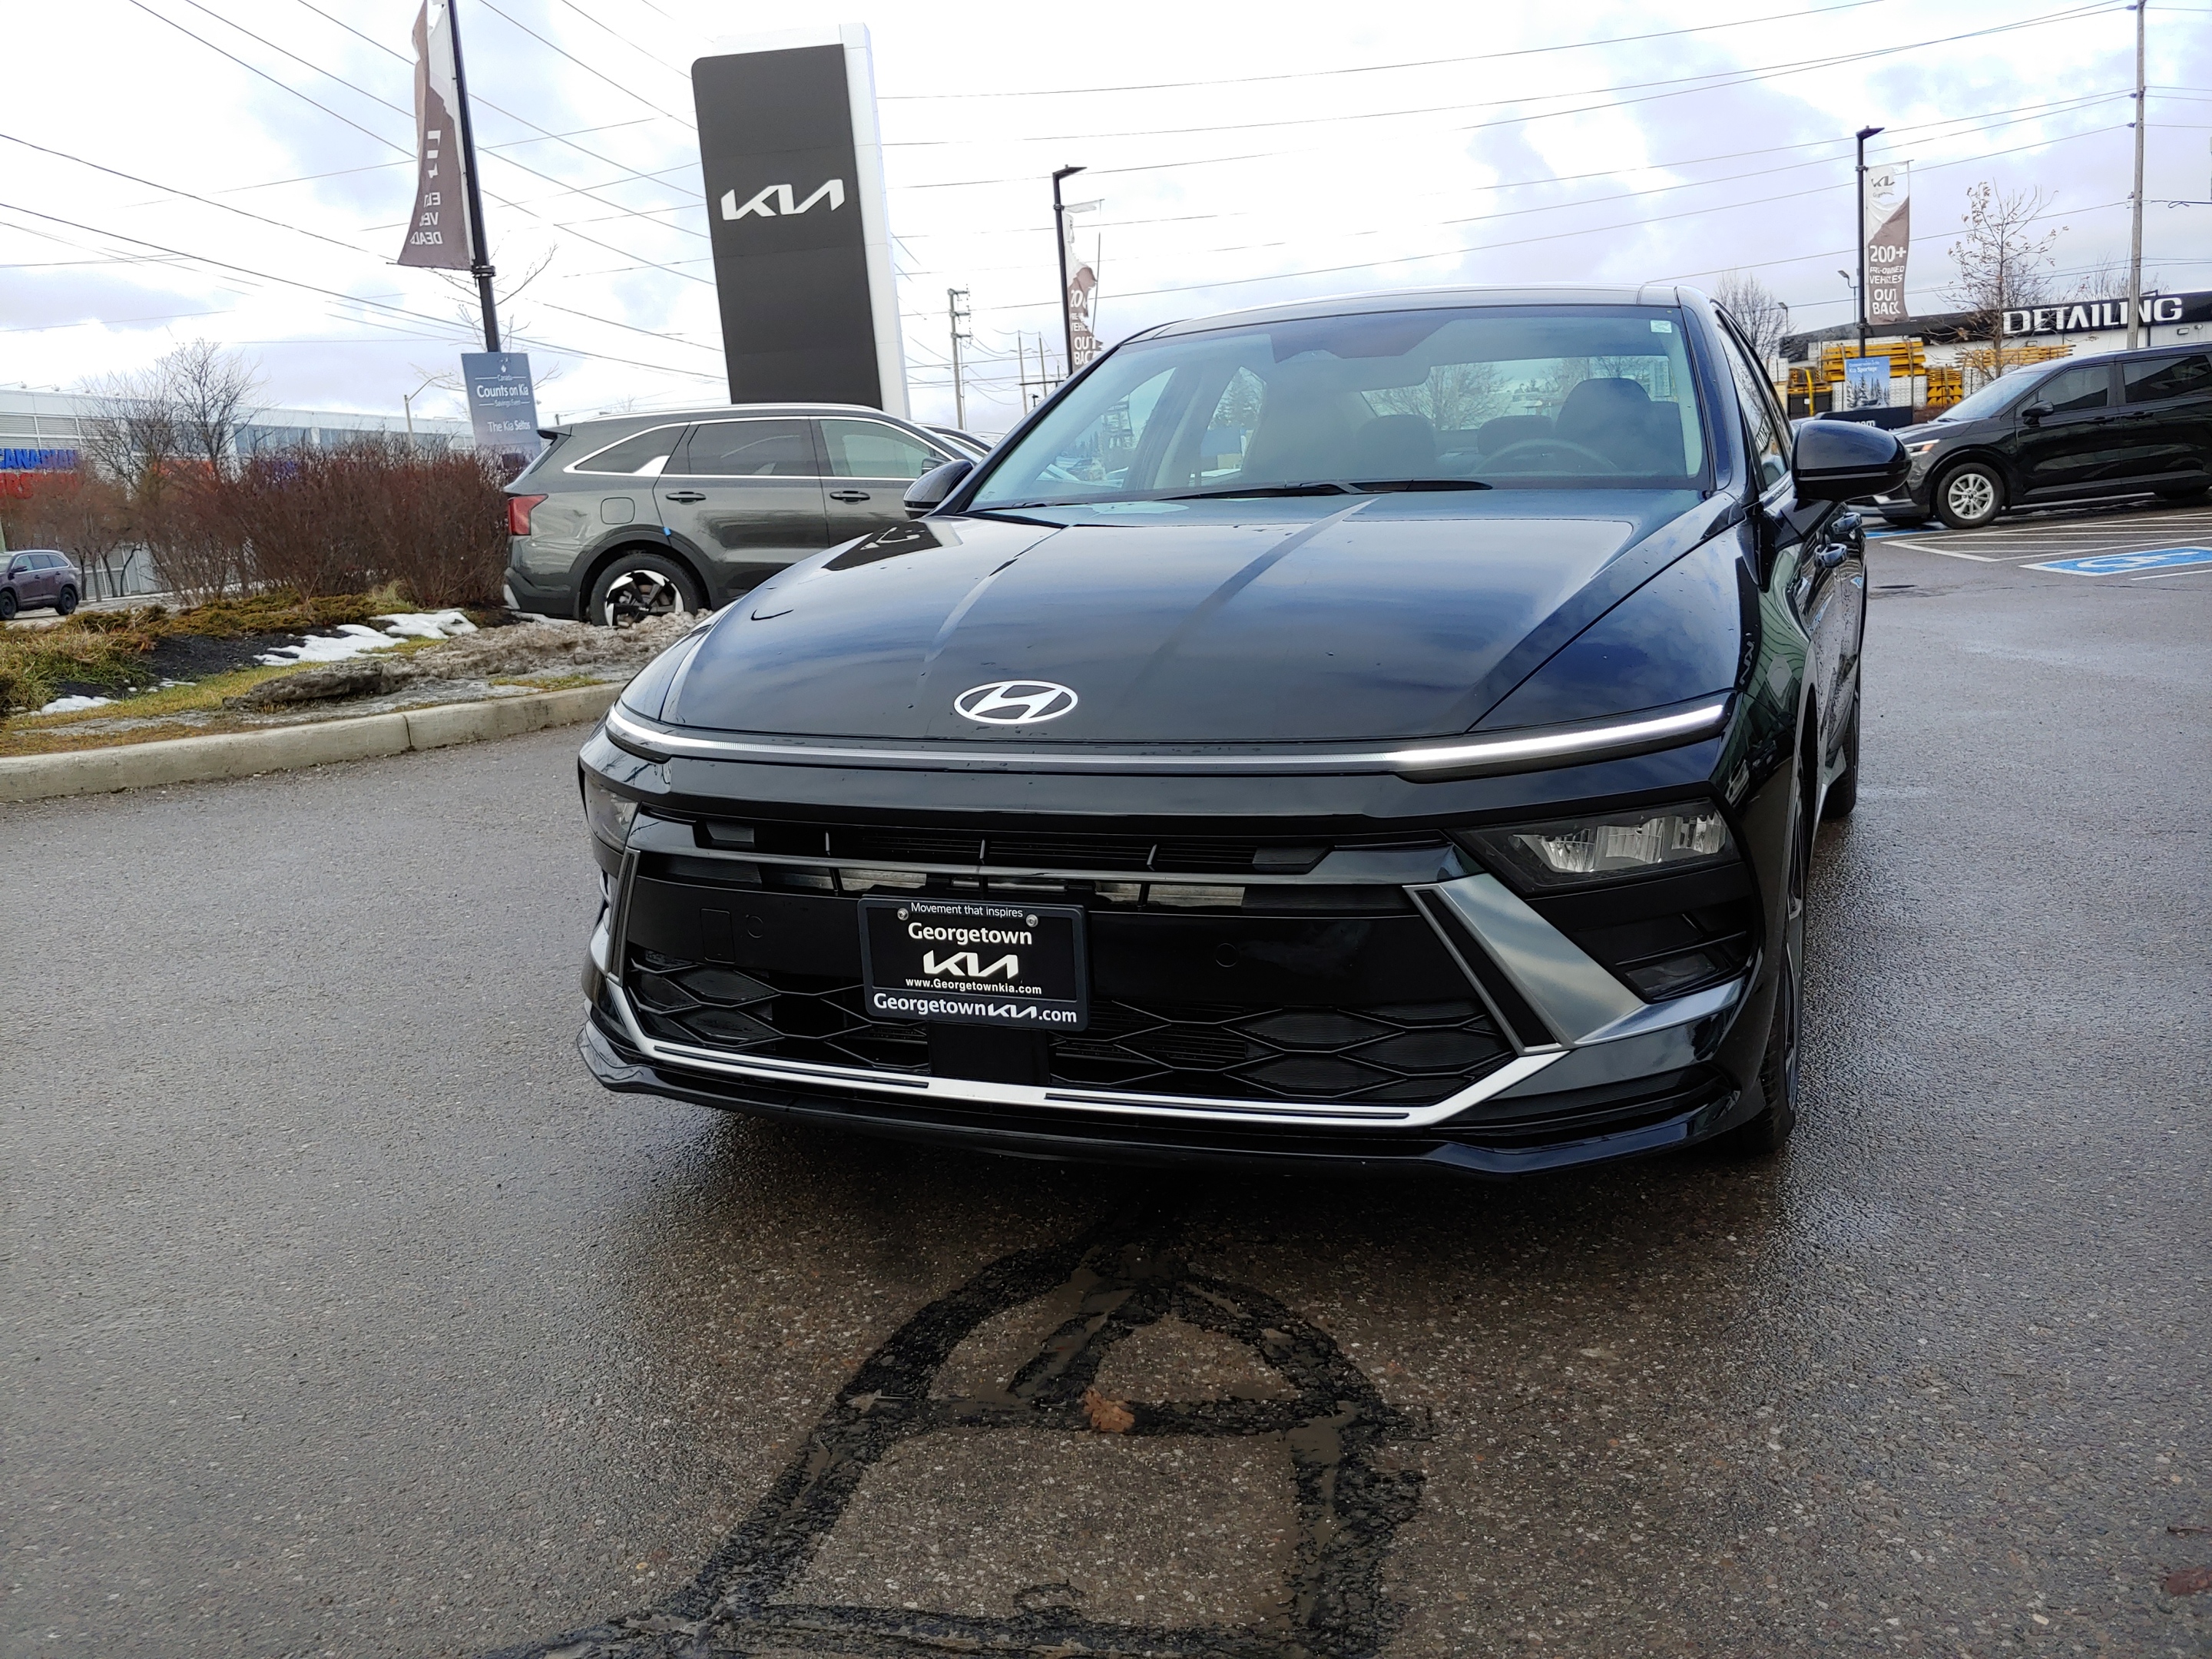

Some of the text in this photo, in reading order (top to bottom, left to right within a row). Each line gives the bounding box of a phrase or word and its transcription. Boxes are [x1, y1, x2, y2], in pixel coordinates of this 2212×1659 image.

[720, 179, 845, 221] KIA
[1869, 245, 1906, 263] 200+
[1869, 265, 1905, 274] PRE-OWNED
[1869, 274, 1903, 284] VEHICLES
[1874, 288, 1896, 301] OUT
[1872, 301, 1901, 315] BACK
[2002, 297, 2183, 335] DETAILING
[1074, 336, 1096, 350] OUT
[1074, 351, 1093, 366] BAC
[477, 383, 529, 398] Counts on Kia
[487, 422, 502, 432] The
[503, 420, 514, 431] Kia
[911, 902, 1023, 918] Movement that inspires
[908, 922, 1032, 945] Georgetown
[923, 949, 1018, 979] KIA
[906, 978, 1042, 995] www.Georgetownkia.com
